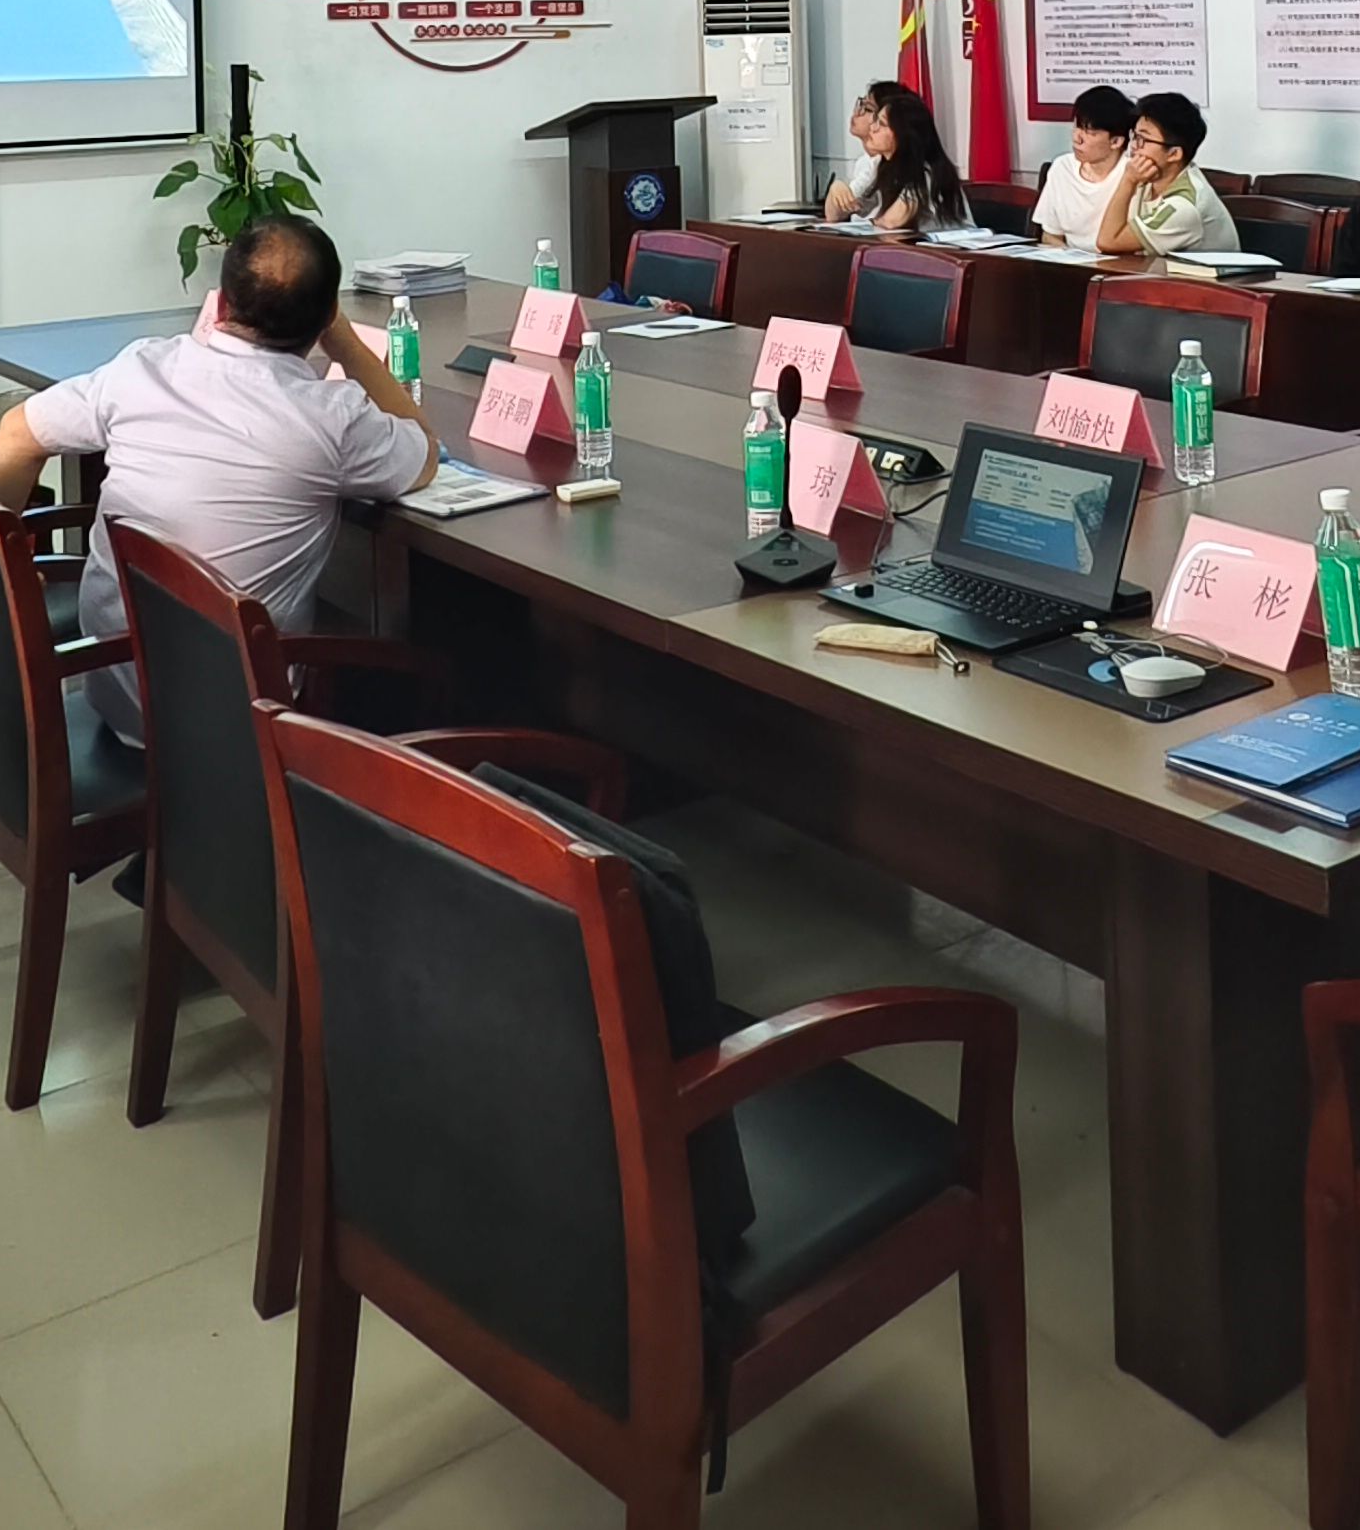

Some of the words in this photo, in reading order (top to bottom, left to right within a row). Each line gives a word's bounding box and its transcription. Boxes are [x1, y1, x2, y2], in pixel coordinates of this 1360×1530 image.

[1043, 403, 1114, 447] 刘愉快
[1183, 558, 1292, 621] 张彬
